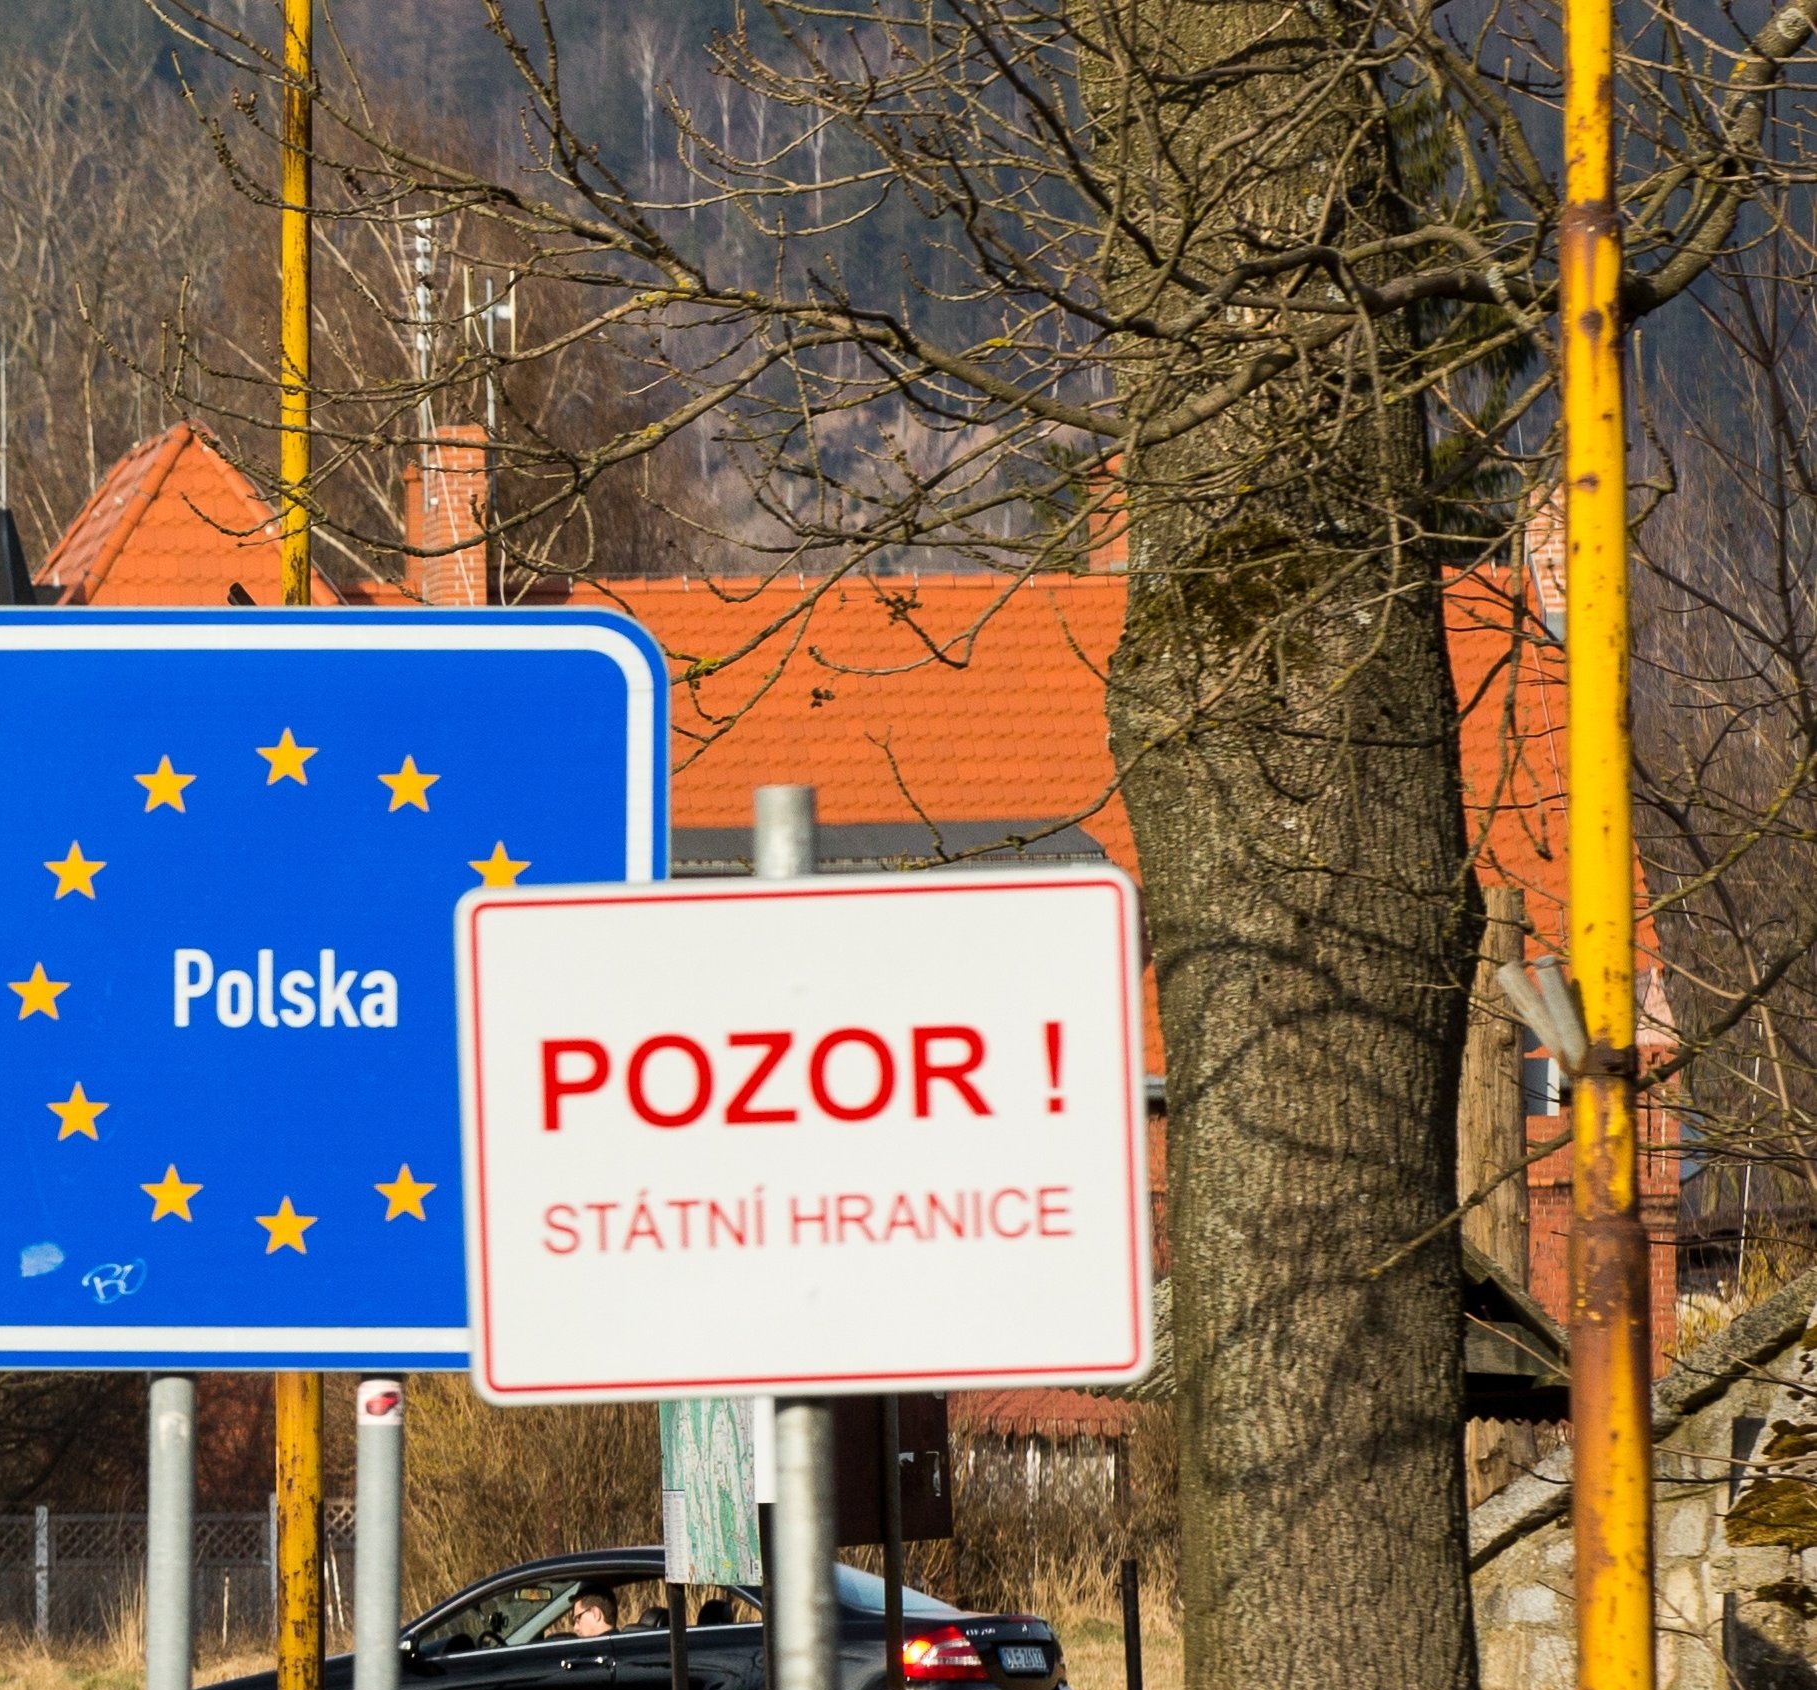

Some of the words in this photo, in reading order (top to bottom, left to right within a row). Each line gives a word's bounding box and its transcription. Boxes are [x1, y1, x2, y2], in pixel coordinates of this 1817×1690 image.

[174, 948, 398, 1028] Polska
[541, 1025, 994, 1132] POZOR
[543, 1187, 764, 1256] STÁTNÍ
[790, 1187, 1072, 1244] HRANICE
